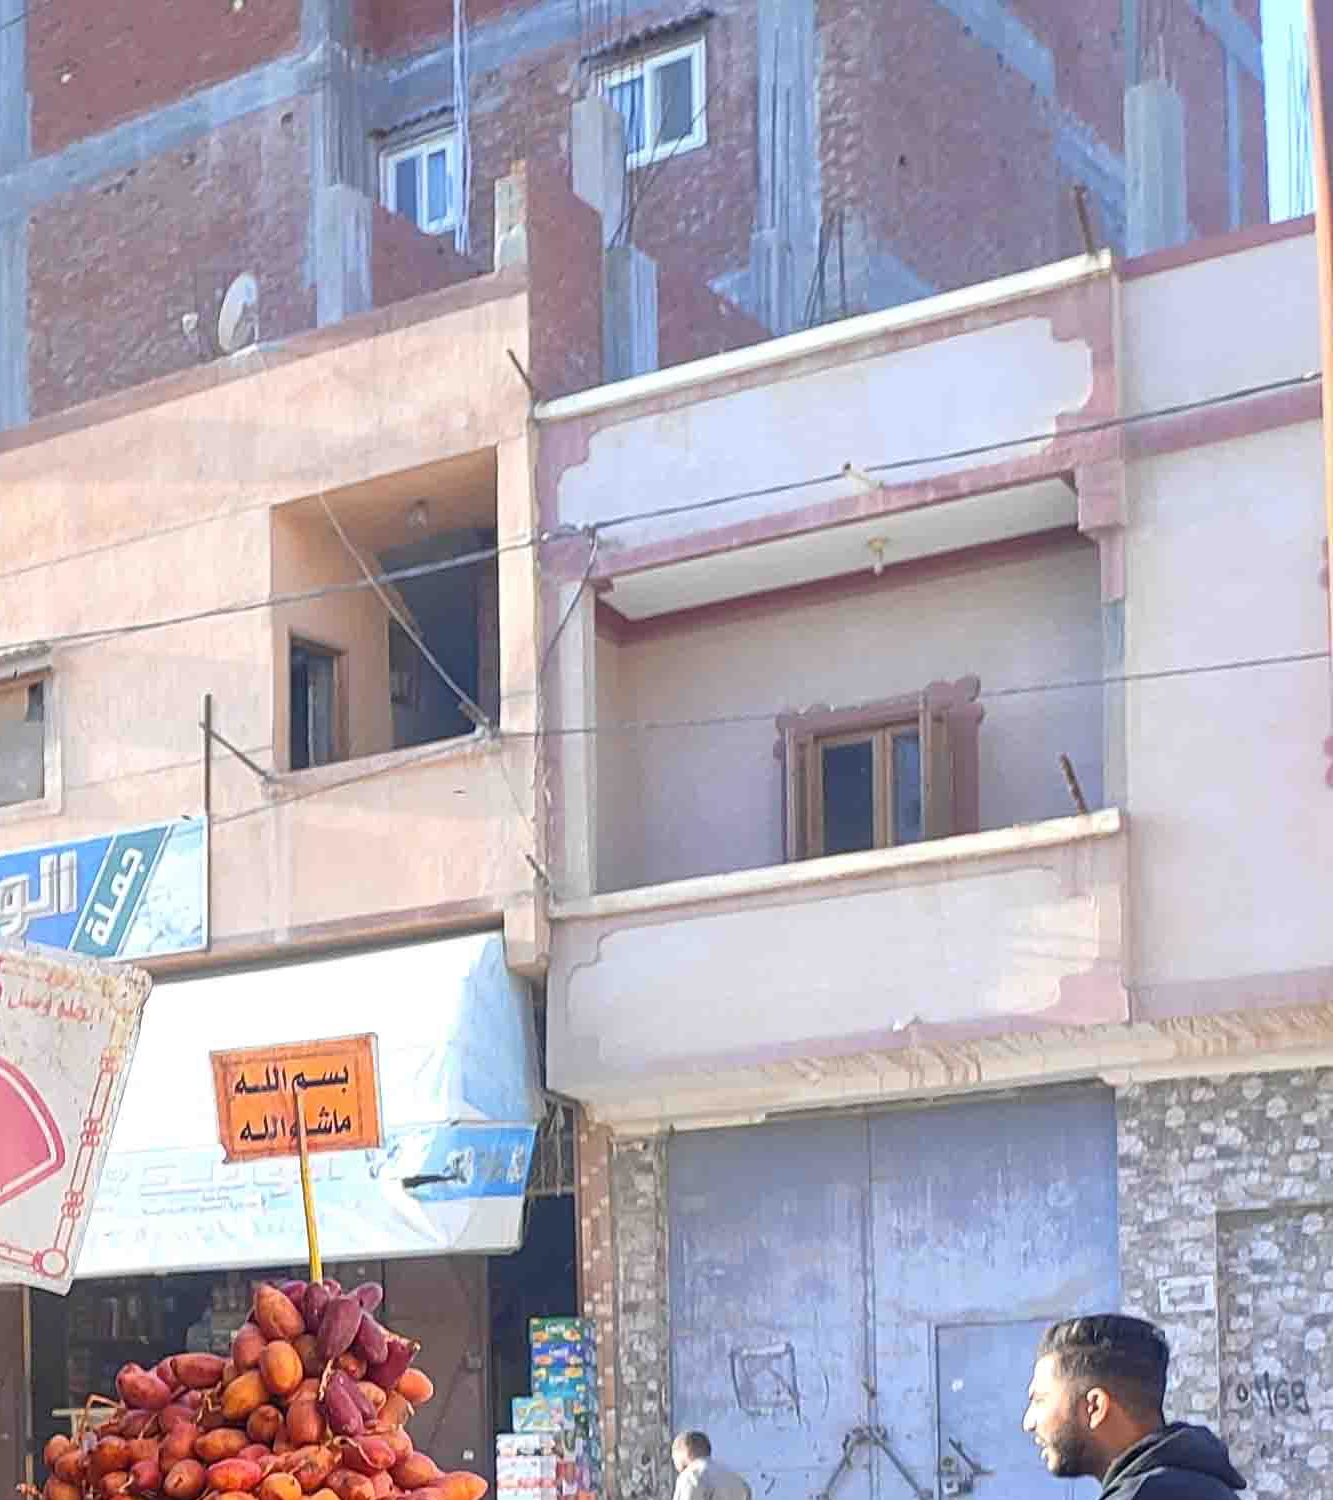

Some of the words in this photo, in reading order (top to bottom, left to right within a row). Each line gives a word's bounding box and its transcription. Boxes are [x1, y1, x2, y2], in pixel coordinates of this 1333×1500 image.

[85, 848, 144, 945] جملة
[234, 1063, 287, 1095] الله
[291, 1064, 349, 1096] بسم
[239, 1113, 286, 1141] الله
